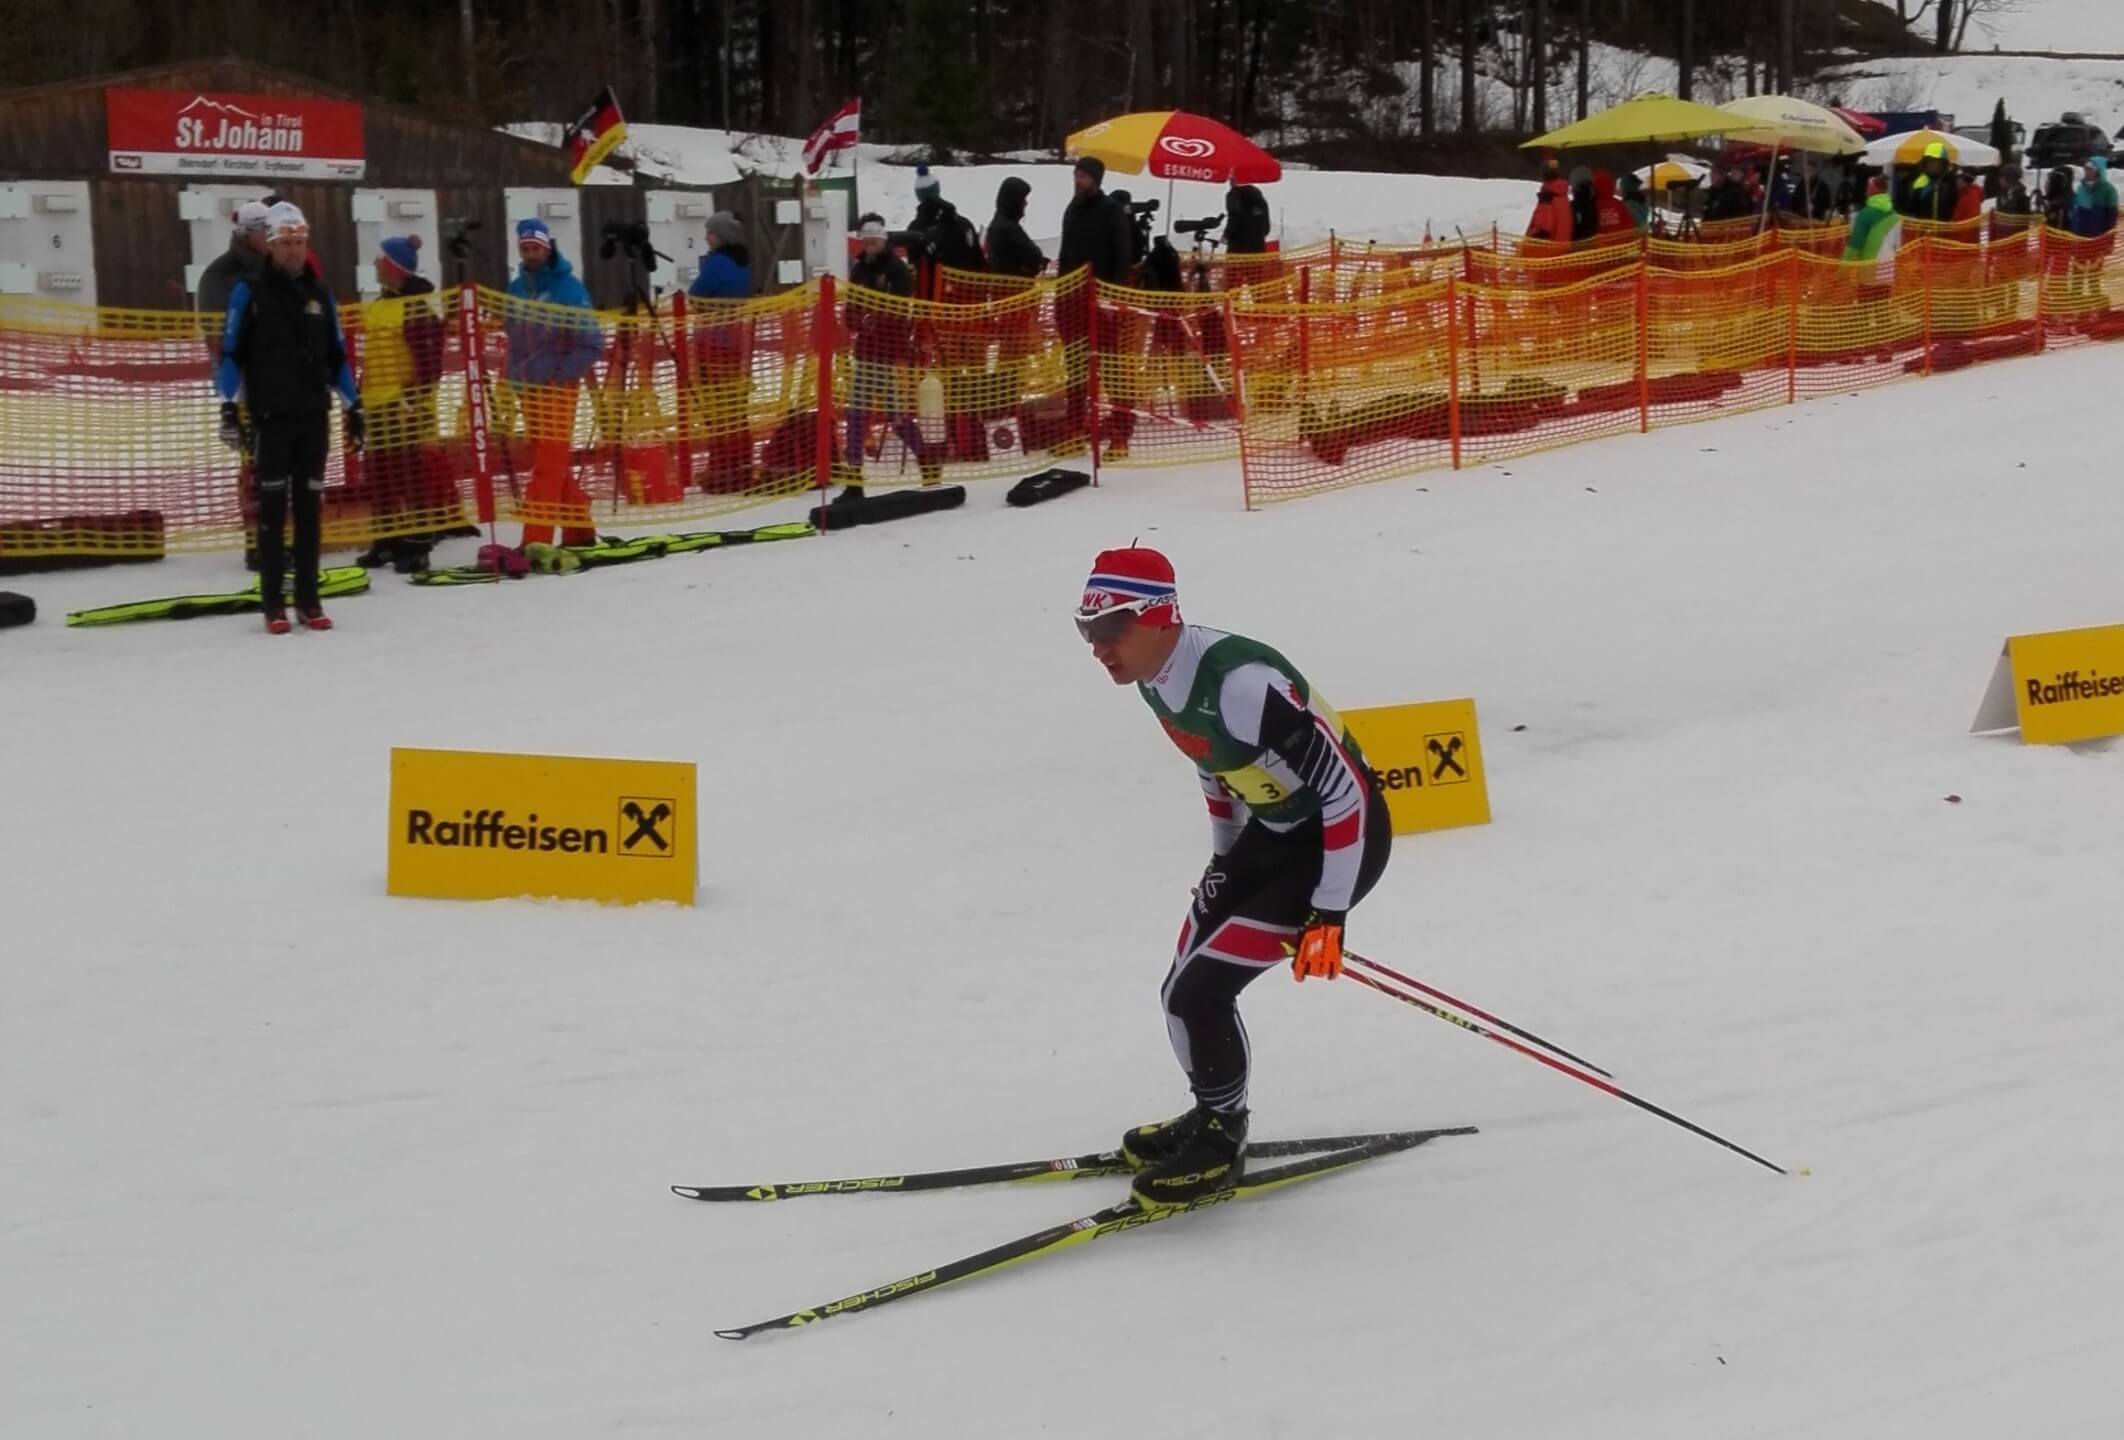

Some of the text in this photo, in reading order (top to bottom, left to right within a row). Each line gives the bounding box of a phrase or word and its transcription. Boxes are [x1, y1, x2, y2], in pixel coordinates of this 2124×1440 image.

[1163, 163, 1214, 180] ESKIMO
[2026, 669, 2124, 706] Raiffeise
[1260, 782, 1281, 800] 3
[407, 808, 608, 854] Raiffeisen
[785, 1176, 905, 1193] FISCHER
[1152, 1164, 1231, 1187] FISCHER
[1091, 1189, 1237, 1240] FISCHER
[825, 1269, 937, 1314] FISCHER
